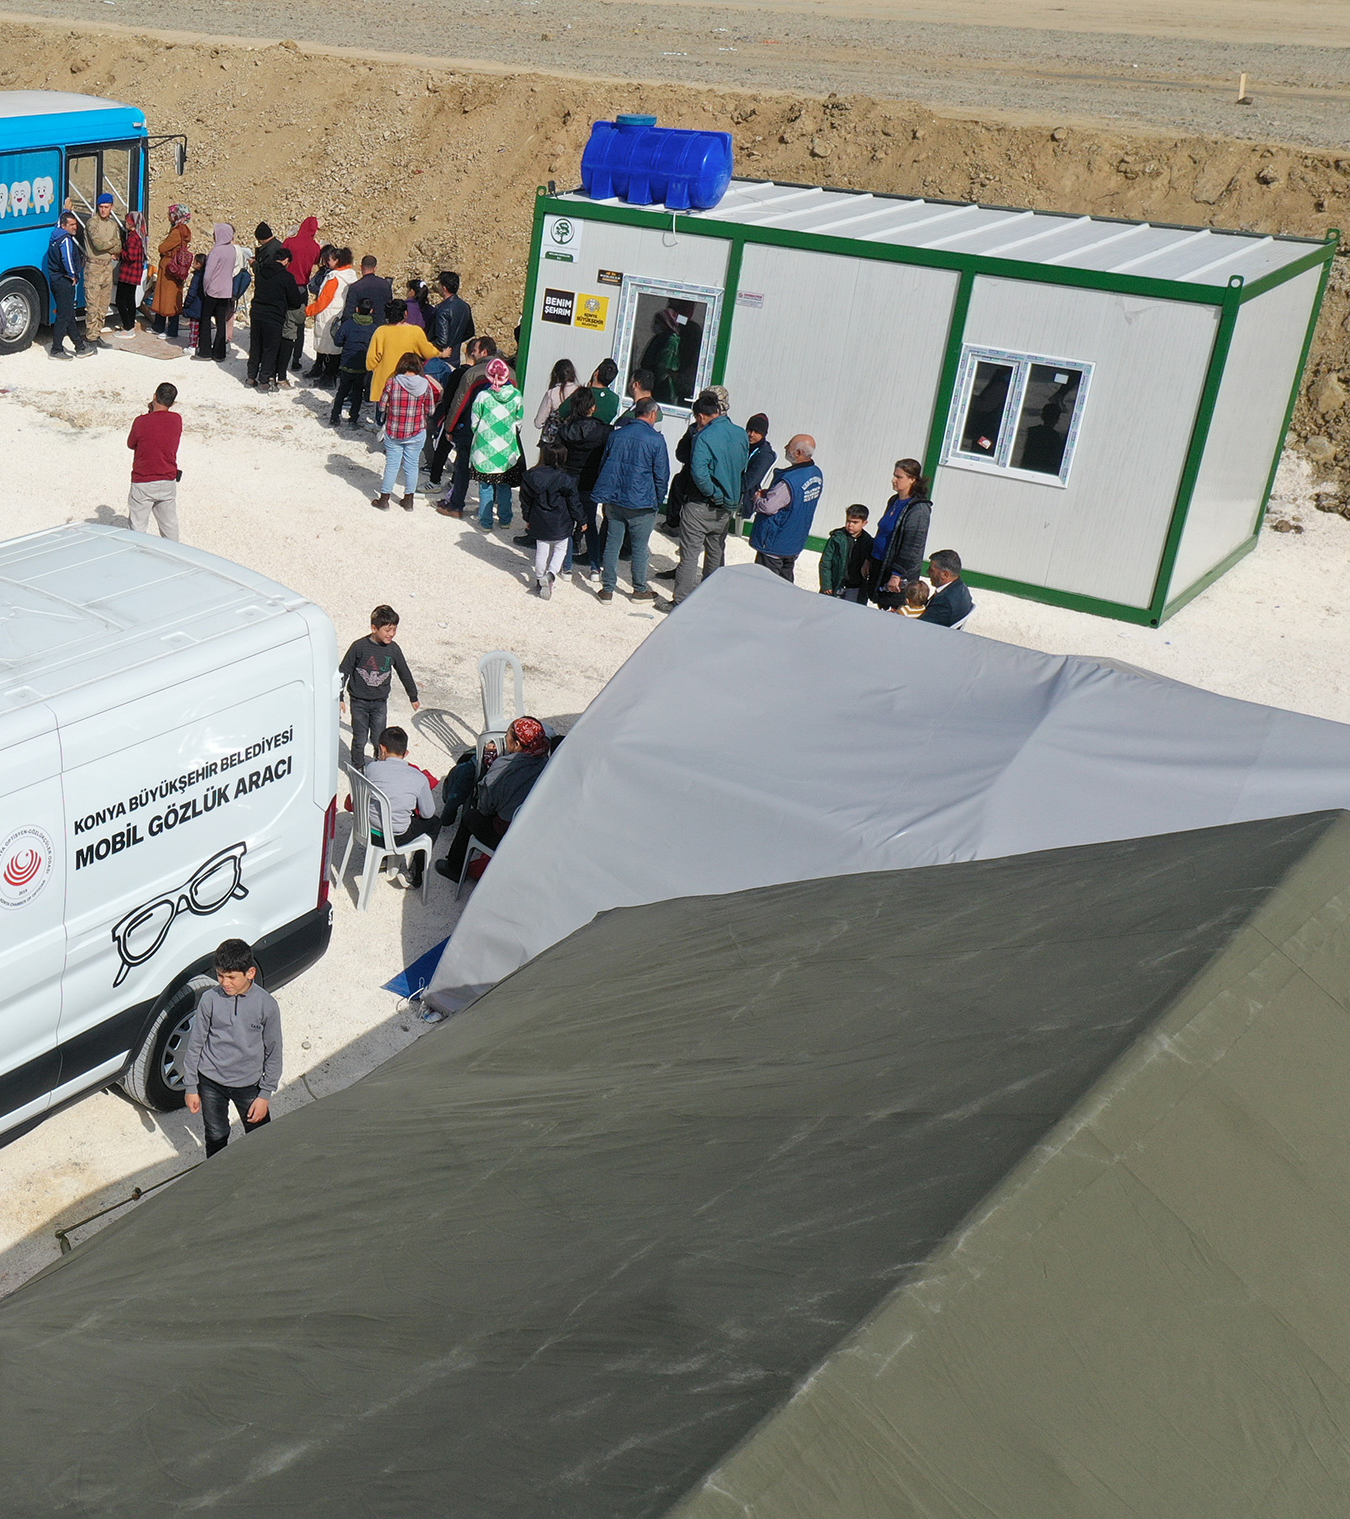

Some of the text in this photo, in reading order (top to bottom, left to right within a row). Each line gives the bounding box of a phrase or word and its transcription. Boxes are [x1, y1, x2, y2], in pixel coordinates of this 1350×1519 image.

[74, 725, 294, 835] KONYA BÜYÜKŞEHİR BELEDİYESİ
[75, 756, 293, 870] MOBİL GÖZLÜK ARACI
